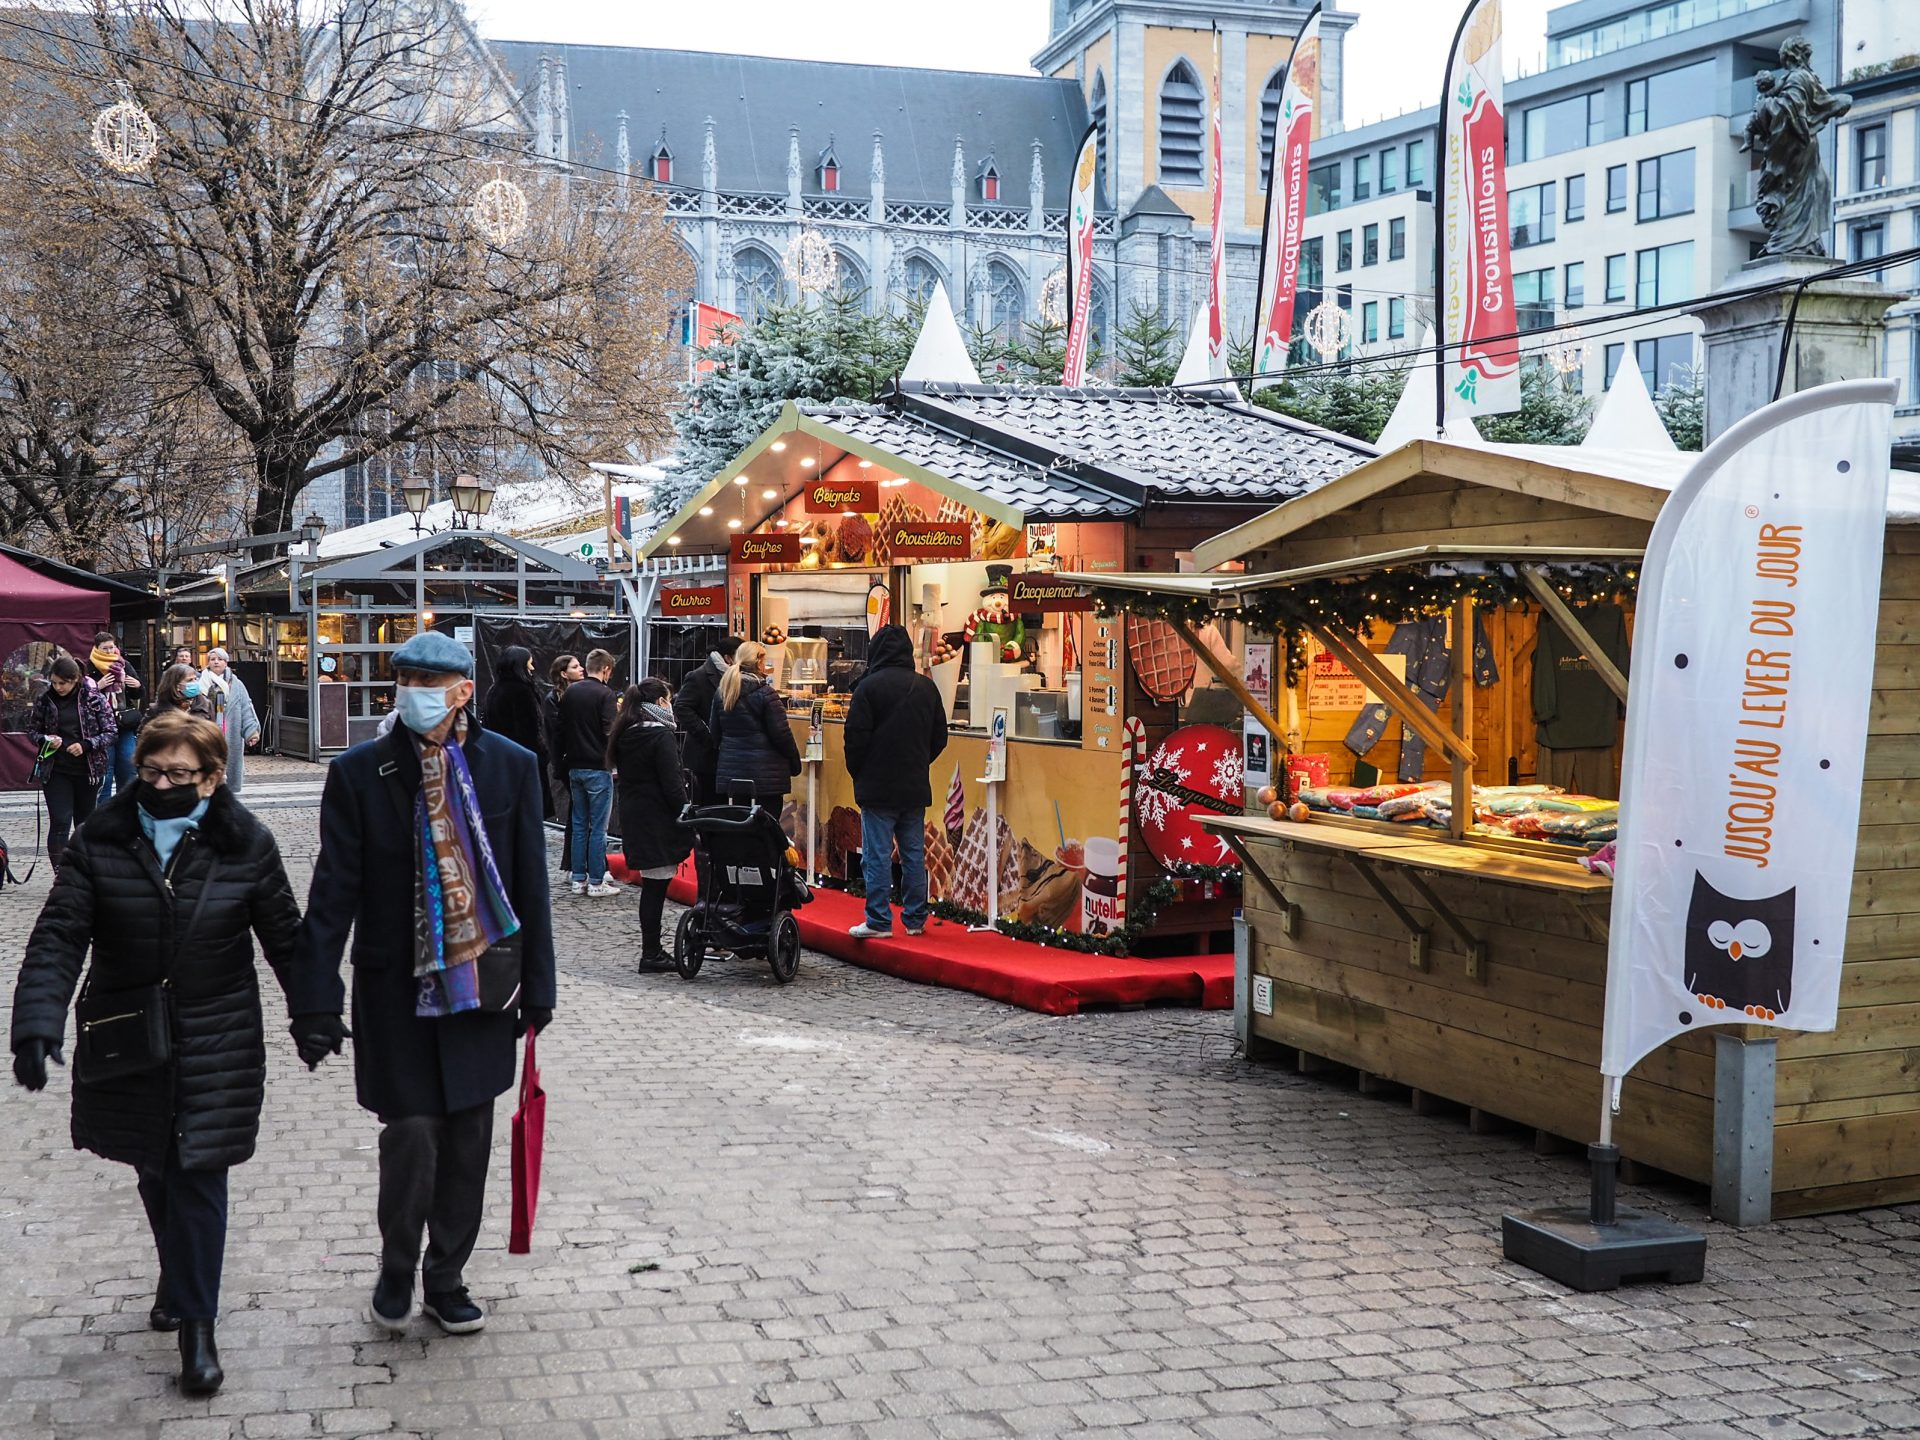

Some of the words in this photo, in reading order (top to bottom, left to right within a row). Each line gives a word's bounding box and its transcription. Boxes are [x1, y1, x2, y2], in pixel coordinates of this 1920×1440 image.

[1478, 146, 1503, 312] Croustillons
[813, 486, 860, 508] Beignets
[895, 530, 963, 548] Croustillons
[1030, 523, 1056, 537] nutella
[742, 539, 783, 559] Gaufres
[1756, 523, 1803, 587] JOUR
[670, 593, 712, 609] Churros
[1013, 581, 1081, 605] Lacqueman
[1750, 599, 1797, 637] DU
[1738, 649, 1792, 729] LEVER
[1724, 737, 1782, 869] JUSQU'AU
[1085, 896, 1117, 920] nutell
